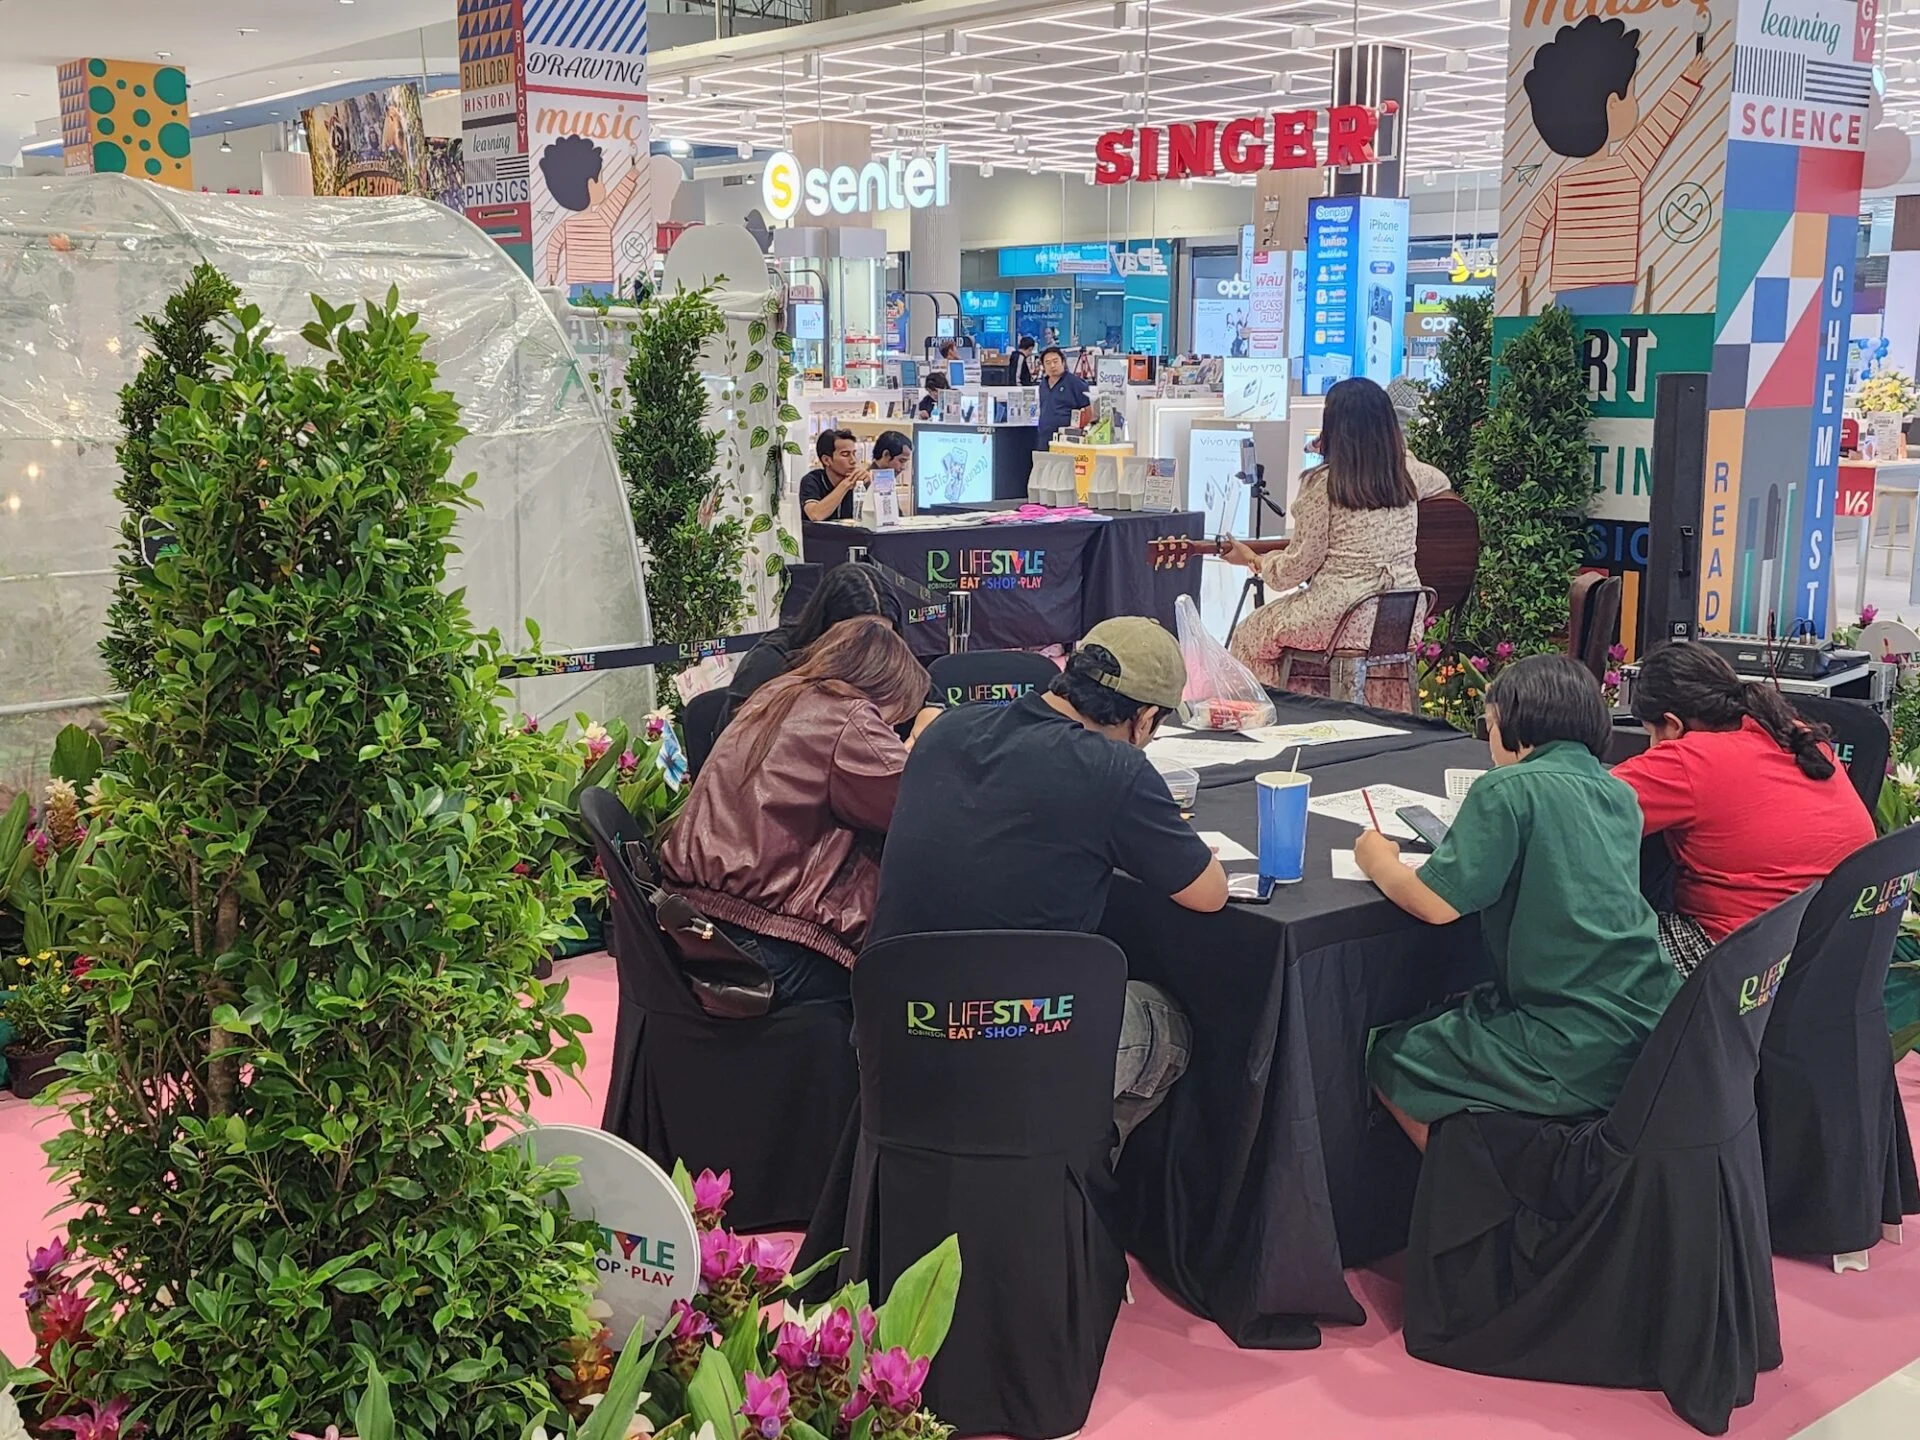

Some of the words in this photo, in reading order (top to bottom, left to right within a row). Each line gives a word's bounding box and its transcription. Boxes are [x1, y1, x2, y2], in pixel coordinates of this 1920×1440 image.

[1761, 0, 1841, 56] learning
[464, 59, 511, 90] BIOLOGY
[527, 52, 644, 87] DRAWING
[515, 30, 527, 144] BIOLOGY
[464, 92, 512, 113] HISTORY
[535, 105, 643, 143] music
[1742, 102, 1862, 145] SCIENCE
[473, 132, 511, 154] learning
[1095, 104, 1381, 186] SINGER
[805, 143, 950, 217] sentel
[466, 179, 529, 205] PHYSICS
[1315, 206, 1353, 222] Senpay
[1369, 218, 1399, 232] iPhone
[1217, 279, 1251, 299] opp
[1253, 300, 1283, 312] GLASS
[1260, 311, 1283, 323] FILM
[1421, 316, 1459, 333] opp
[1231, 362, 1259, 373] vivo
[1261, 363, 1281, 373] V70
[1583, 328, 1658, 403] RT
[1099, 371, 1125, 388] Senpay
[1200, 436, 1223, 446] vivo
[1844, 489, 1870, 516] V6
[1705, 462, 1729, 621] READ
[960, 550, 1045, 575] LIFESTYLE
[960, 577, 981, 589] EAT
[987, 577, 1016, 589] SHOP
[1020, 577, 1042, 589] PLAY
[691, 638, 726, 651] LIFESTYLE
[948, 995, 1074, 1026] LIFESTYLE
[908, 1029, 946, 1038] ROBINSON
[949, 1027, 975, 1039] EAT
[985, 1025, 1027, 1038] SHOP
[1035, 1019, 1071, 1035] PLAY
[598, 1225, 675, 1271] TYLE
[631, 1265, 674, 1287] PLAY
